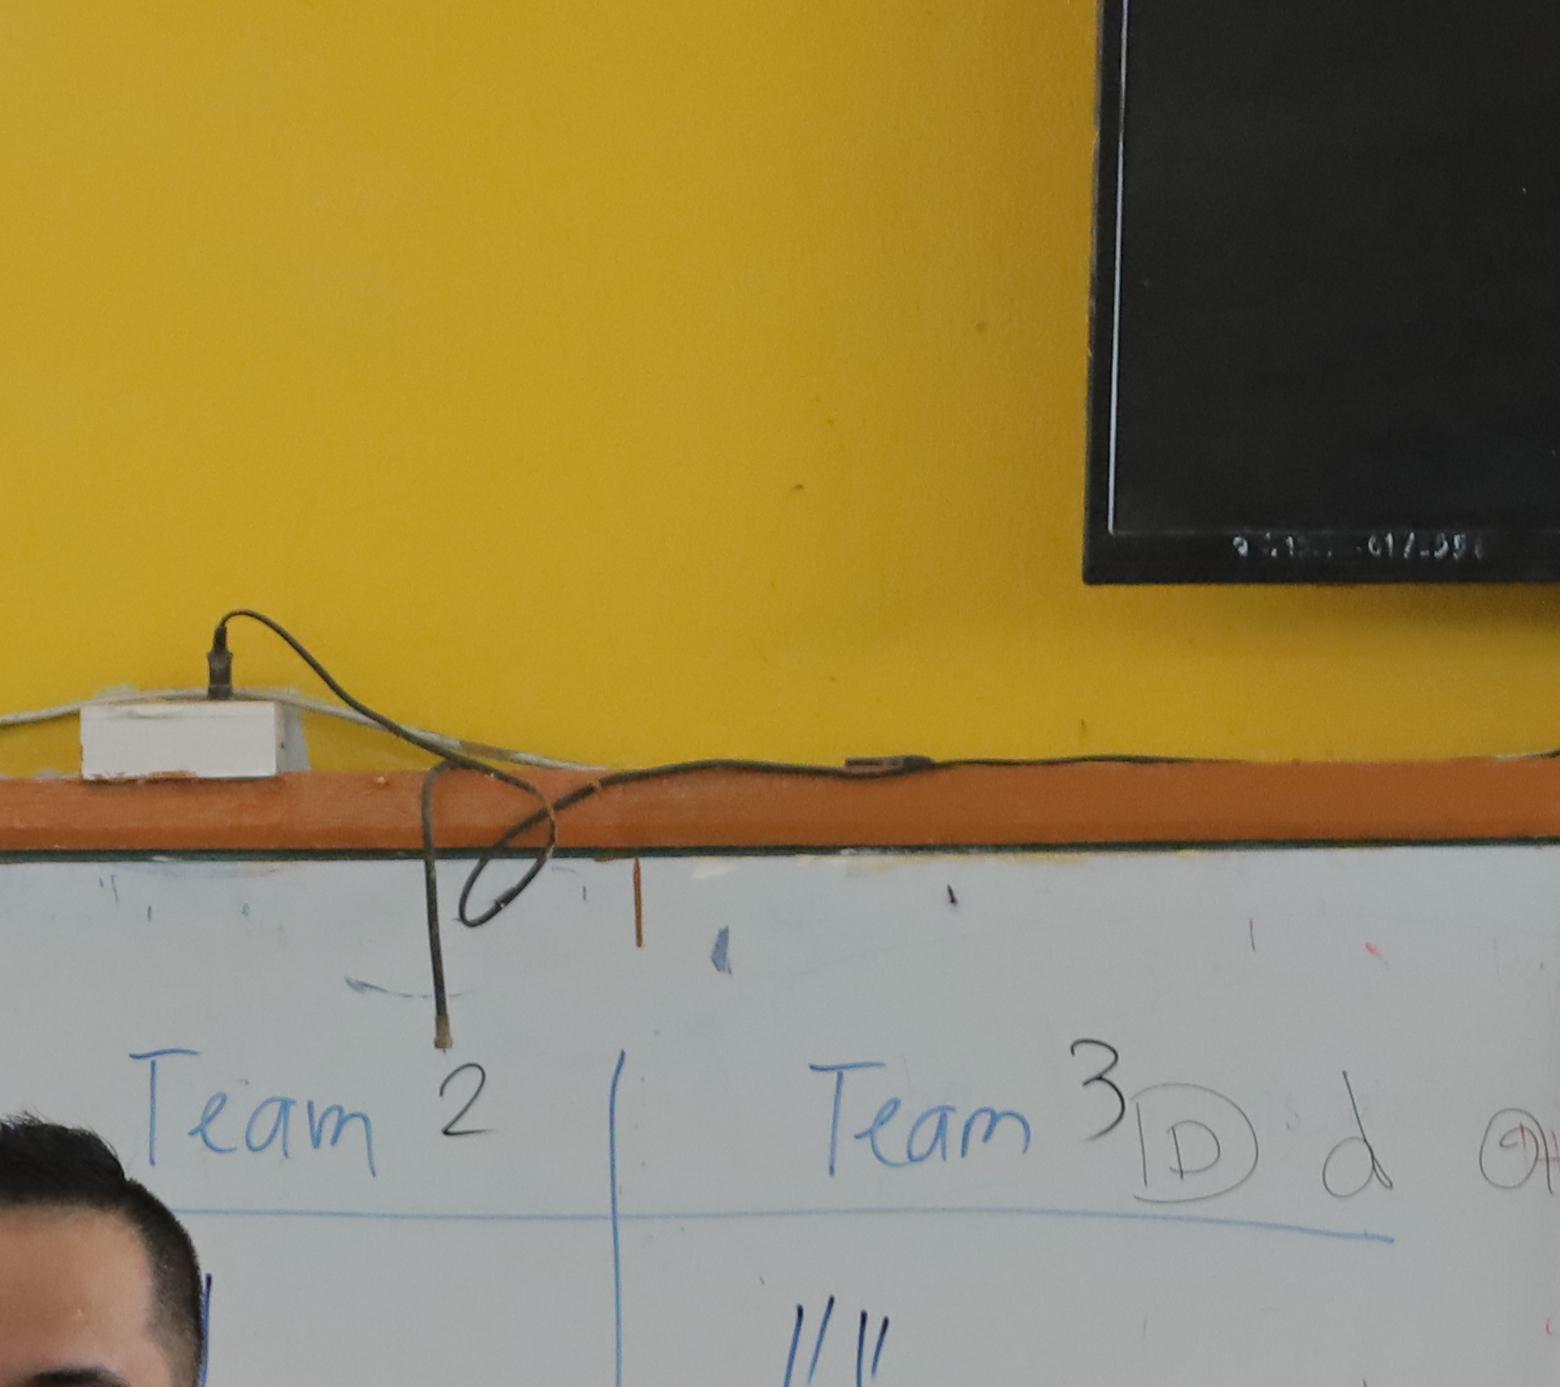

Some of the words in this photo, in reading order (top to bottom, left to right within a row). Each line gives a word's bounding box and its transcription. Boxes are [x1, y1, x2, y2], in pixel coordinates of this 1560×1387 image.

[127, 1048, 377, 1177] Team
[438, 1062, 494, 1137] 2
[808, 1059, 1030, 1177] Team
[1069, 1039, 1127, 1140] 3
